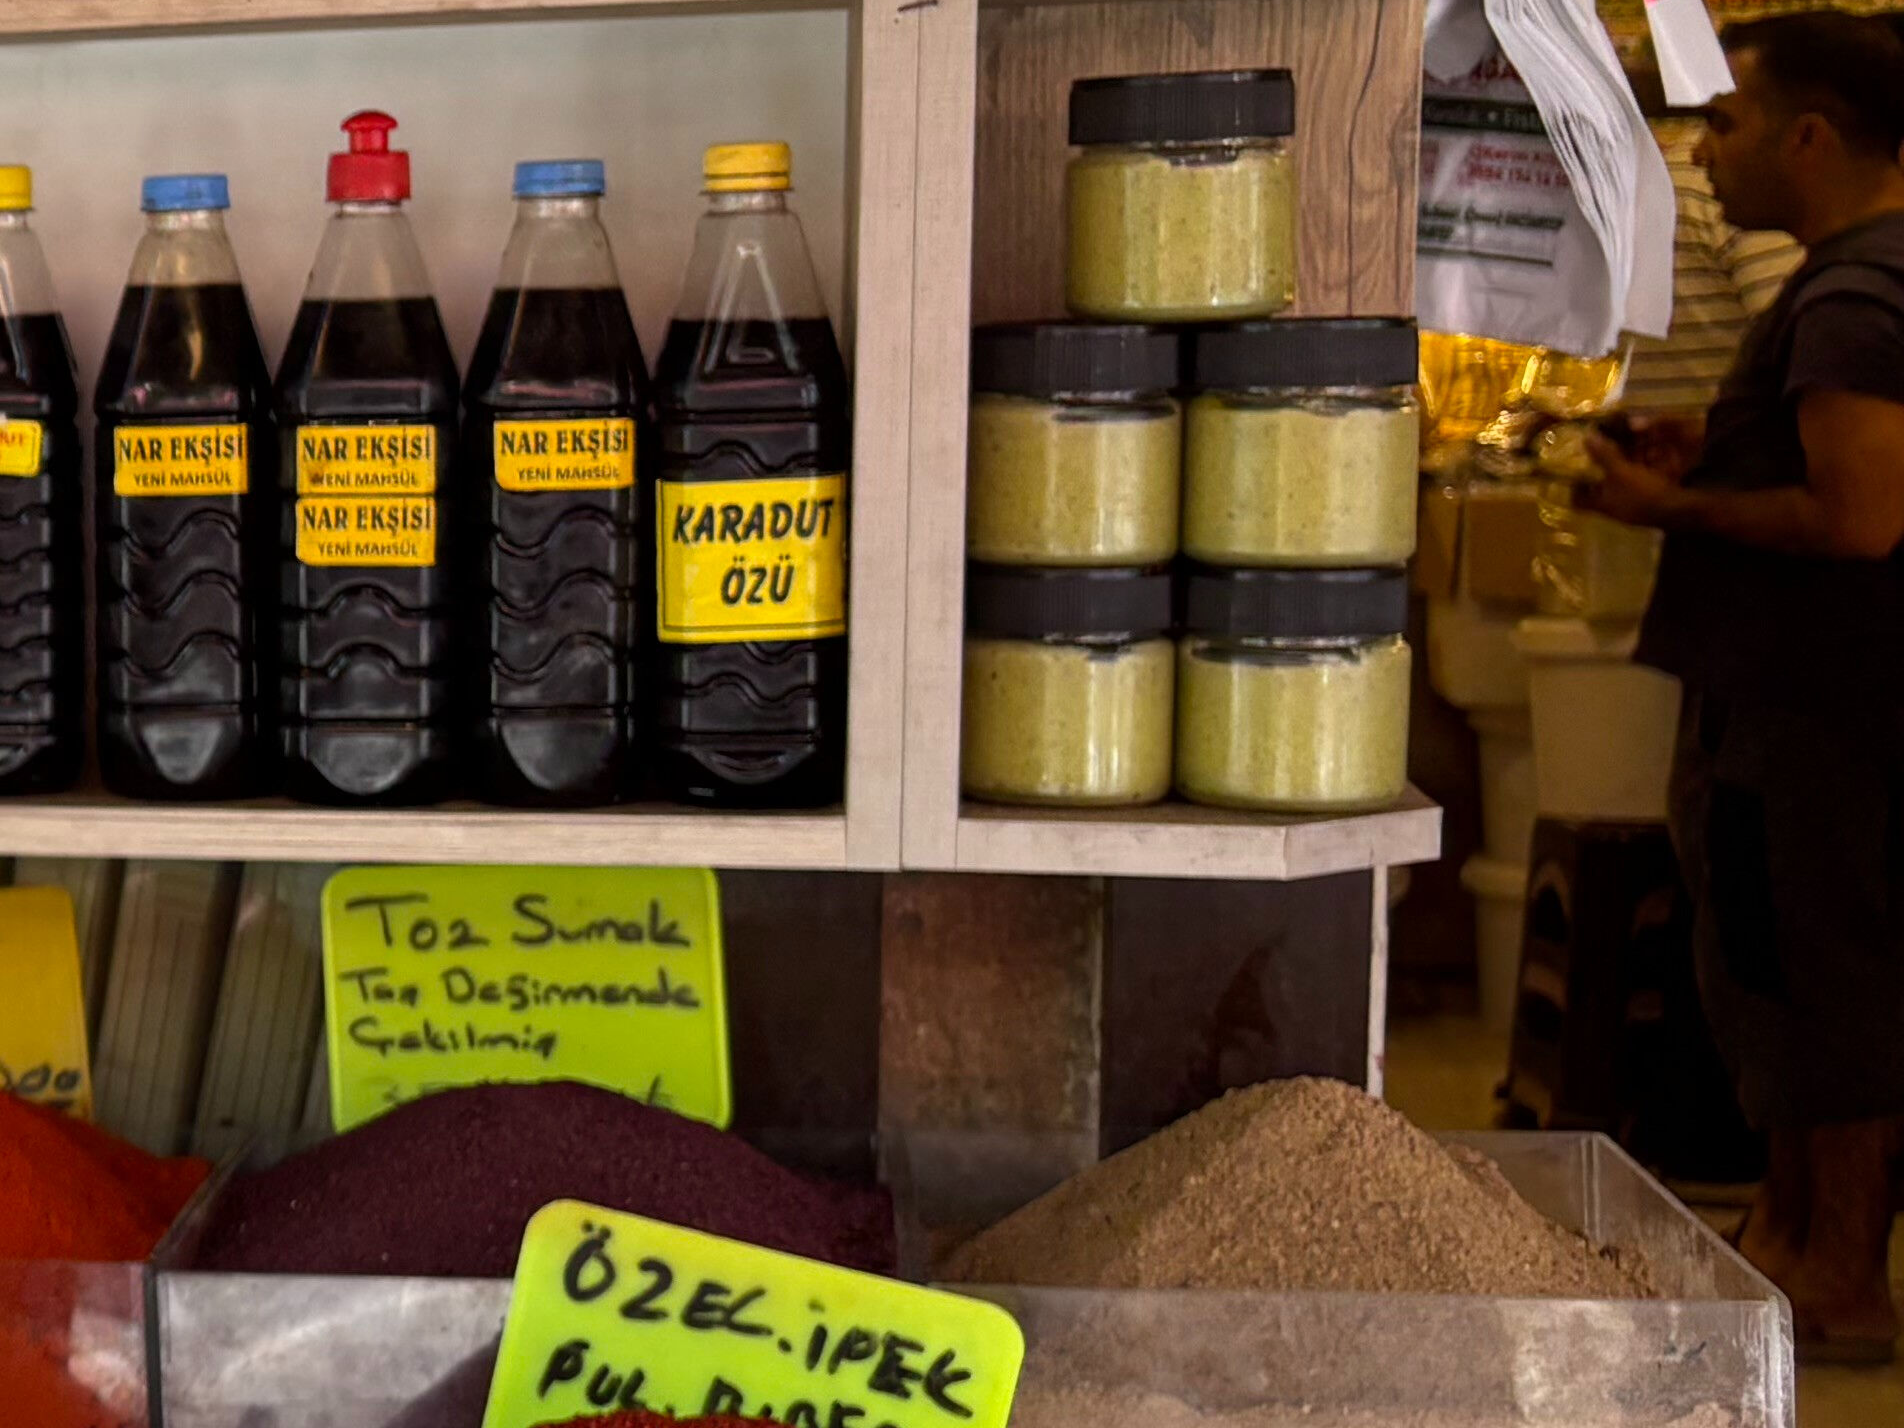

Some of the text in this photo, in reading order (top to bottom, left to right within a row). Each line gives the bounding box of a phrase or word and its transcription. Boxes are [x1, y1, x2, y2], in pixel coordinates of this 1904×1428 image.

[118, 427, 244, 468] NAR EKŞİSİ
[302, 428, 433, 468] NAR EKŞİSİ
[499, 418, 630, 461] NAR EKŞİSİ
[302, 497, 433, 538] NAR EKŞİSİ
[671, 498, 837, 545] KARADUT
[719, 558, 797, 608] ÖZÜ
[510, 893, 692, 950] Sumak
